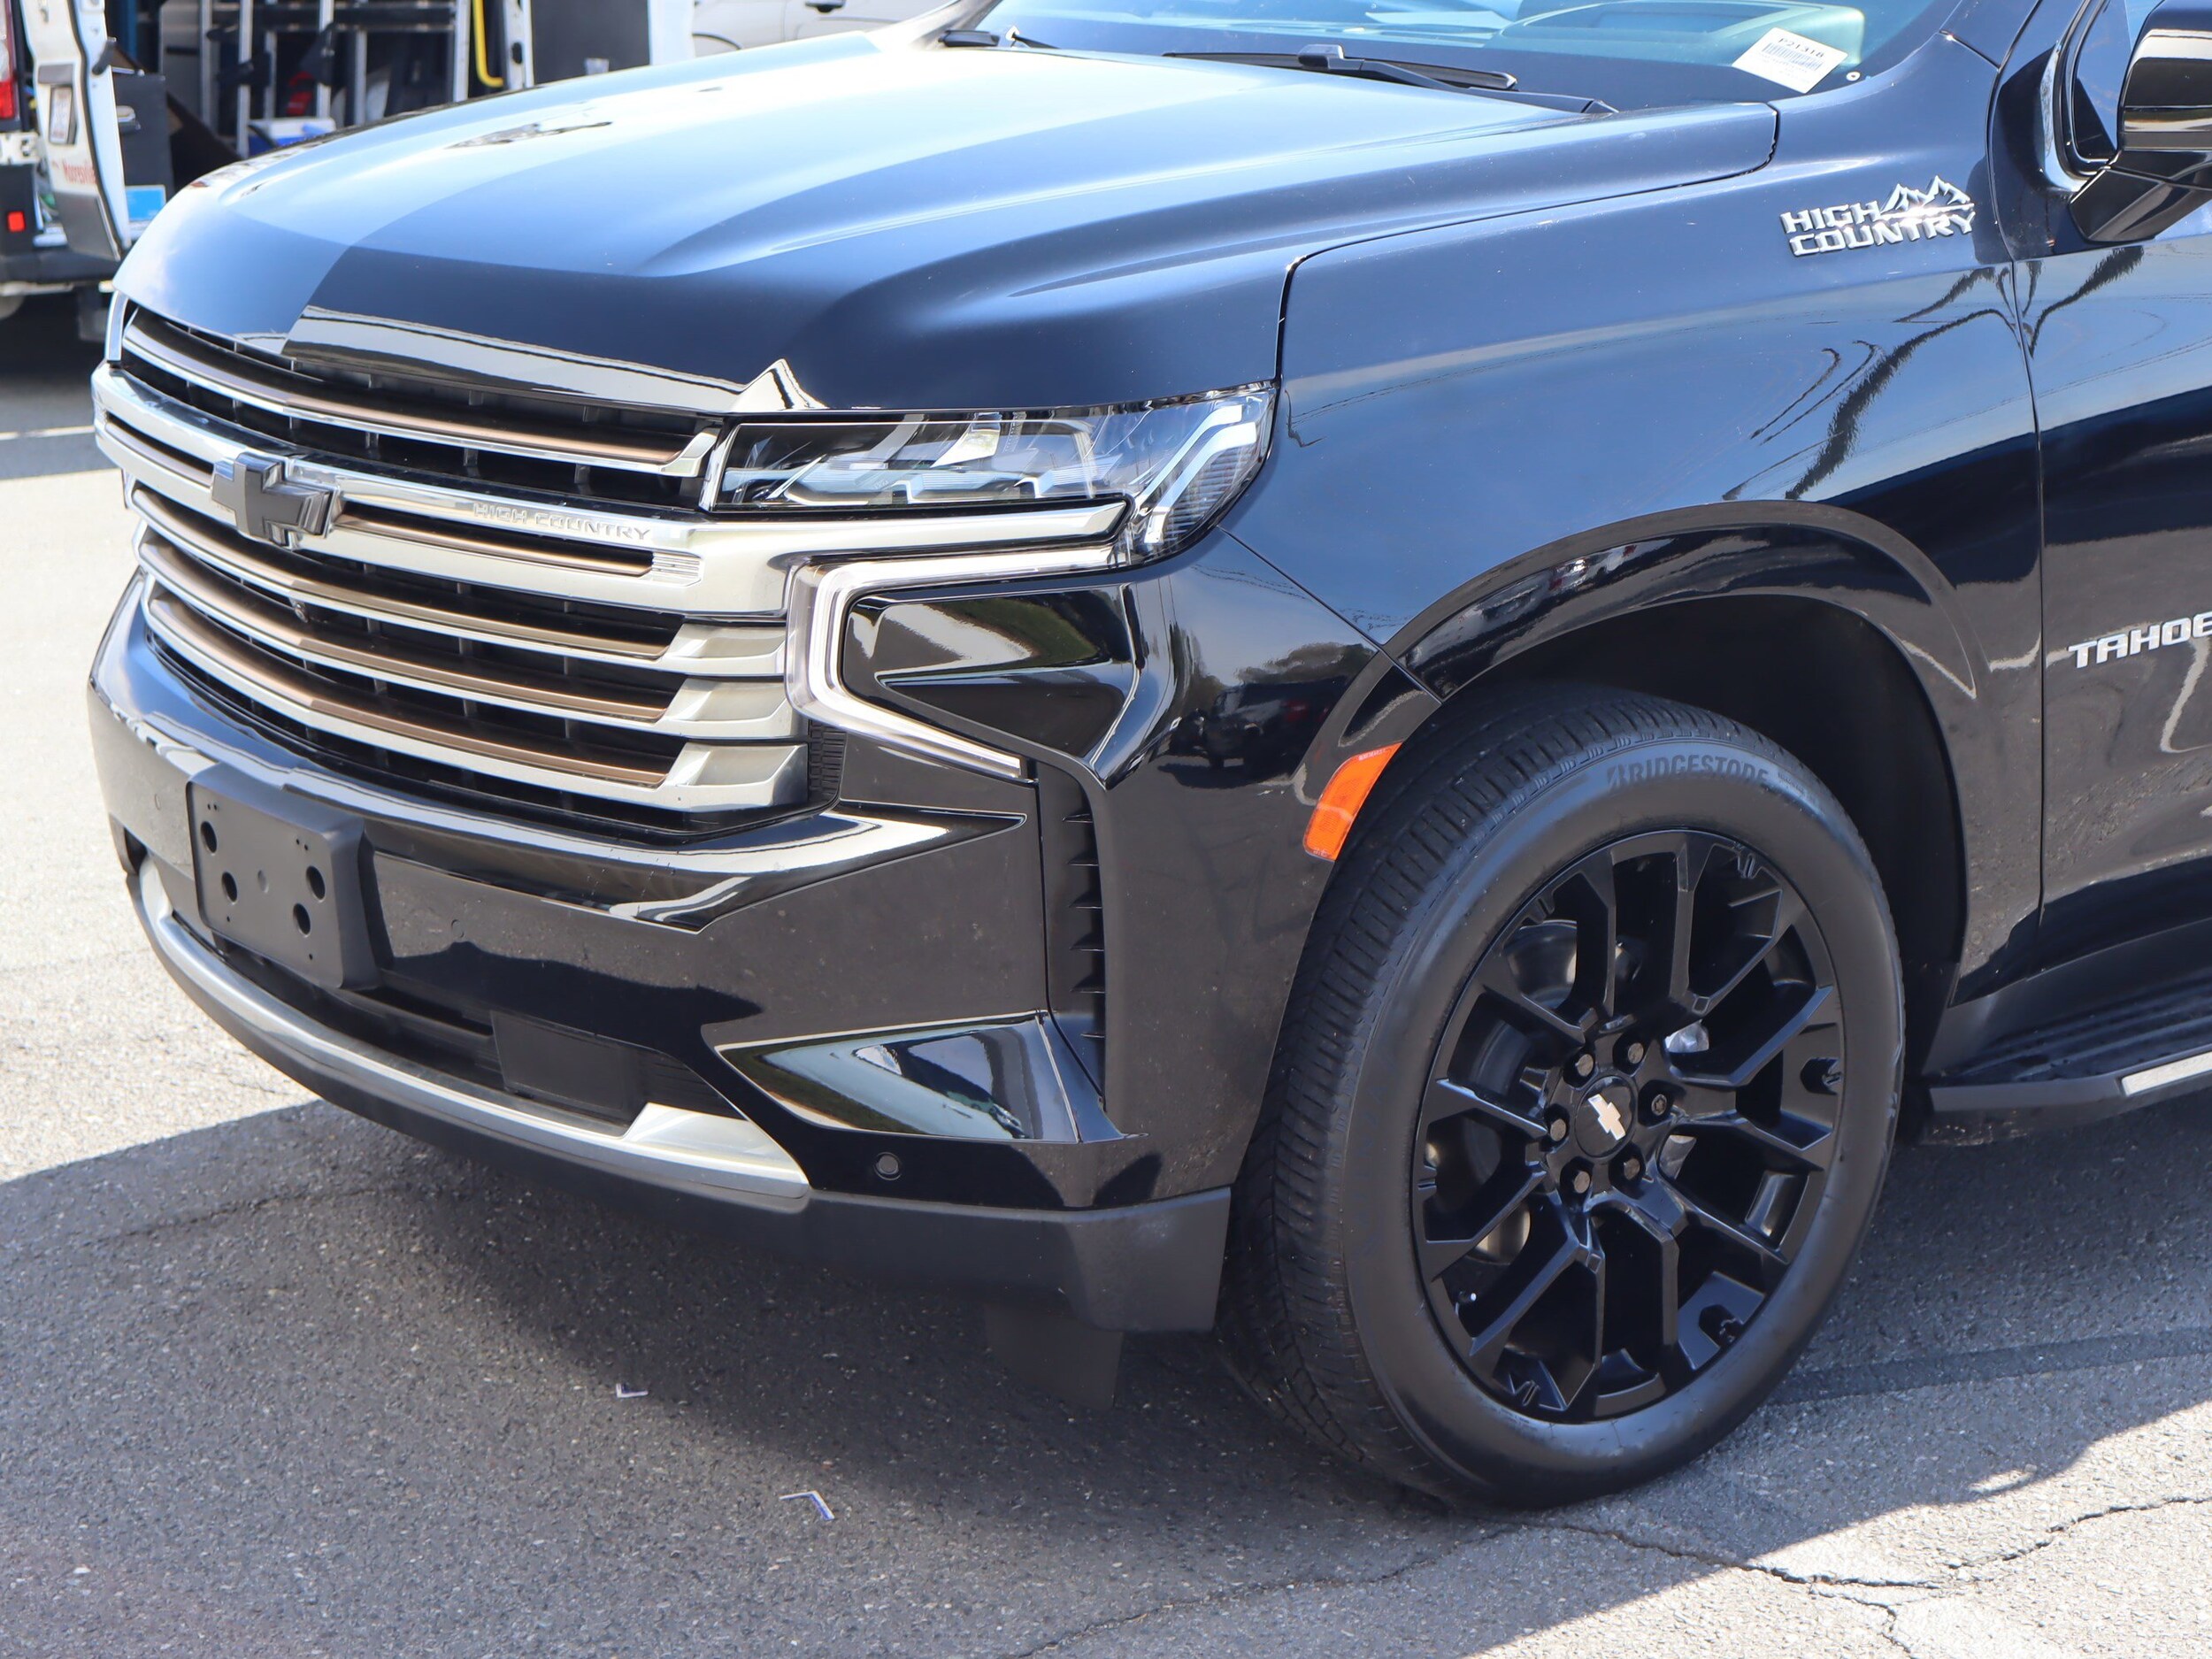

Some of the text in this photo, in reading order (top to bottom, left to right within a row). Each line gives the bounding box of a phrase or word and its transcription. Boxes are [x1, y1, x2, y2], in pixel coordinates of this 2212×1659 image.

[1779, 200, 1881, 234] HIGH
[1789, 211, 1976, 257] COUNTRY
[472, 503, 650, 541] HIGH COUNTRY
[1606, 754, 1770, 789] BRIDGESTONE
